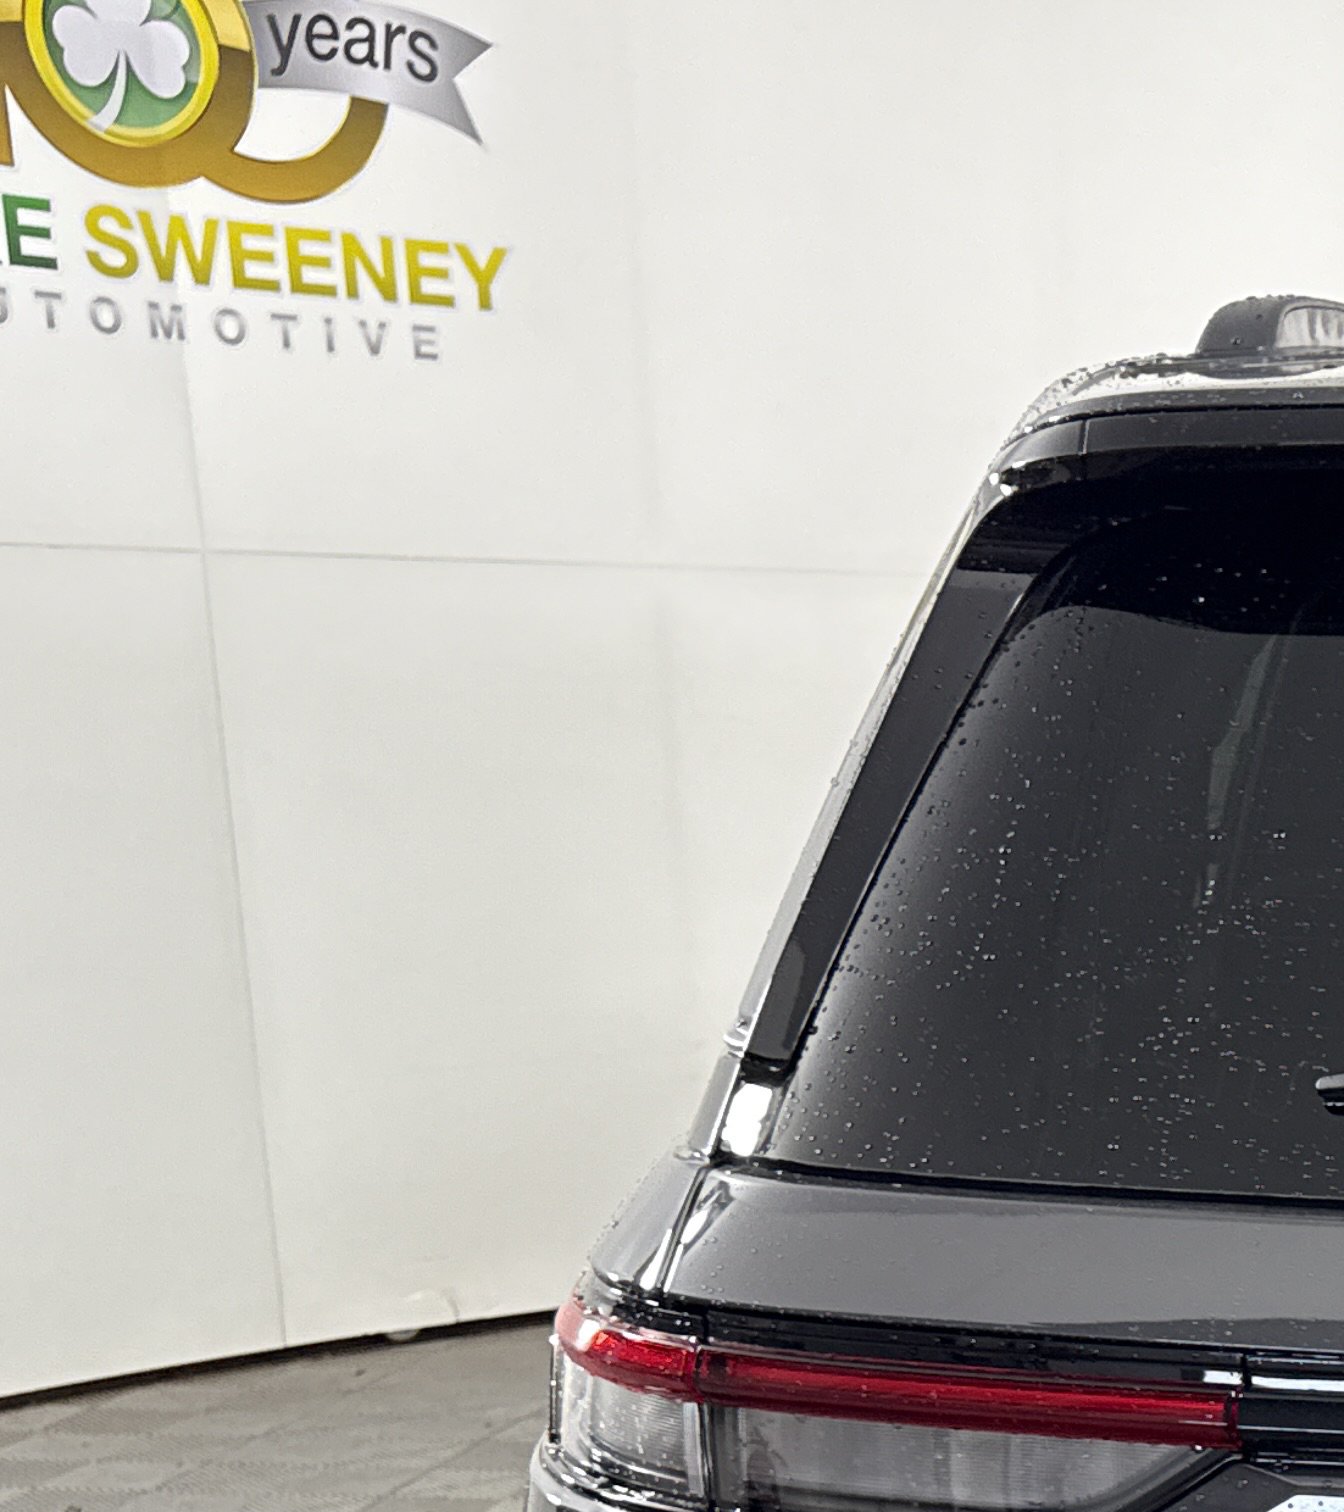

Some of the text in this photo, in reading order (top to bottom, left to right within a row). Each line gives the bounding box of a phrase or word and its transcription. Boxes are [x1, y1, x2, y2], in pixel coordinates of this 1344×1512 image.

[266, 12, 439, 83] years
[0, 0, 389, 205] 00
[84, 202, 508, 311] SWEENEY
[0, 287, 440, 361] TOMOTIVE
